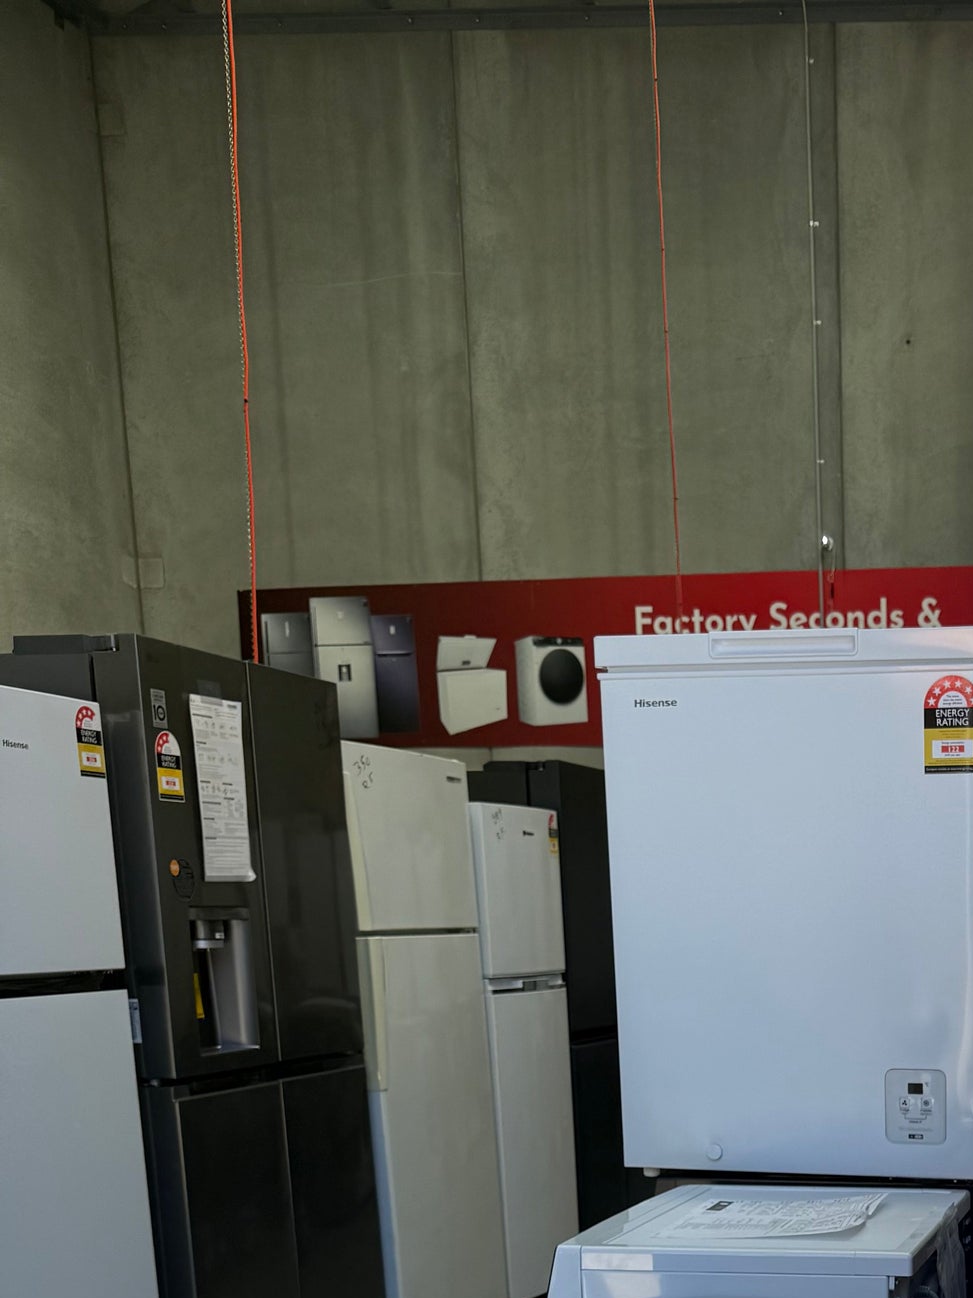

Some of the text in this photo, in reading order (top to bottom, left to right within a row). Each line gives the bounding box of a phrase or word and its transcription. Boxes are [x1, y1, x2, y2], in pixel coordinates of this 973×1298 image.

[634, 598, 942, 635] Factory Seconds &
[634, 699, 677, 708] Hisense
[936, 709, 969, 718] ENERGY
[937, 718, 969, 726] RATING
[3, 739, 29, 750] Hisense
